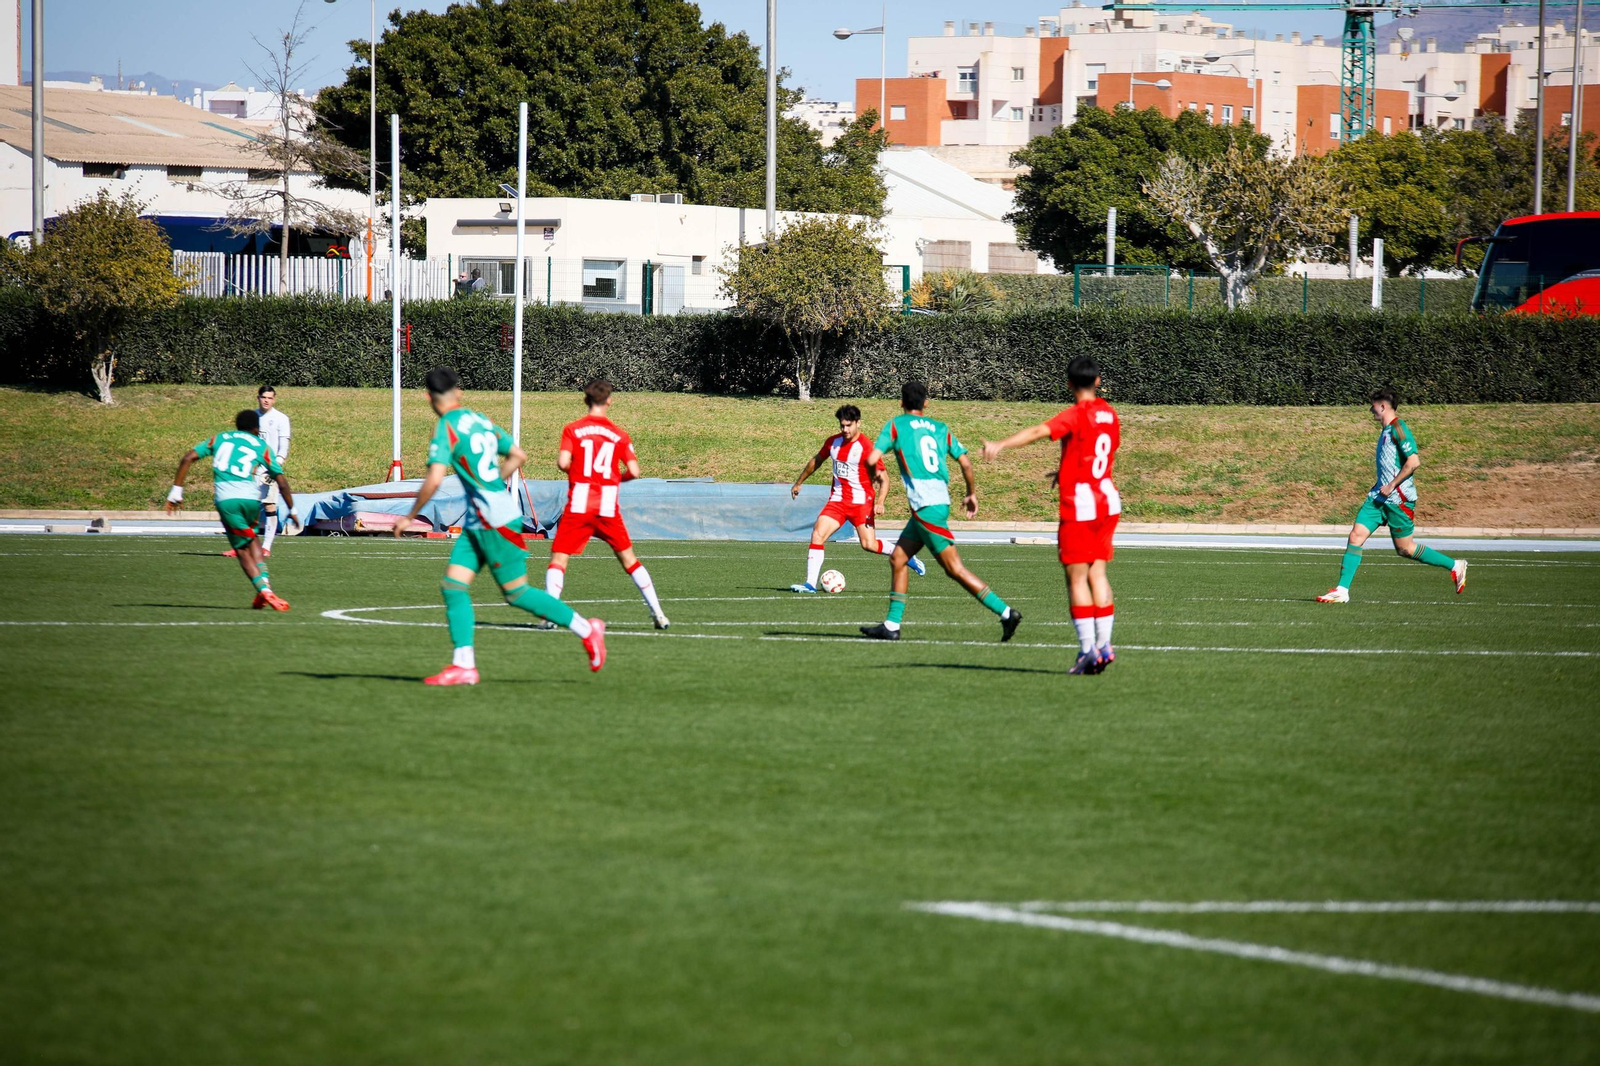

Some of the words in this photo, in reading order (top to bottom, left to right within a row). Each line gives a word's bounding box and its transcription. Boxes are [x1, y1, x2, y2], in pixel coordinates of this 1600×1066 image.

[213, 441, 258, 478] 43
[580, 438, 616, 480] 14
[920, 435, 939, 473] 6
[1091, 433, 1112, 479] 8
